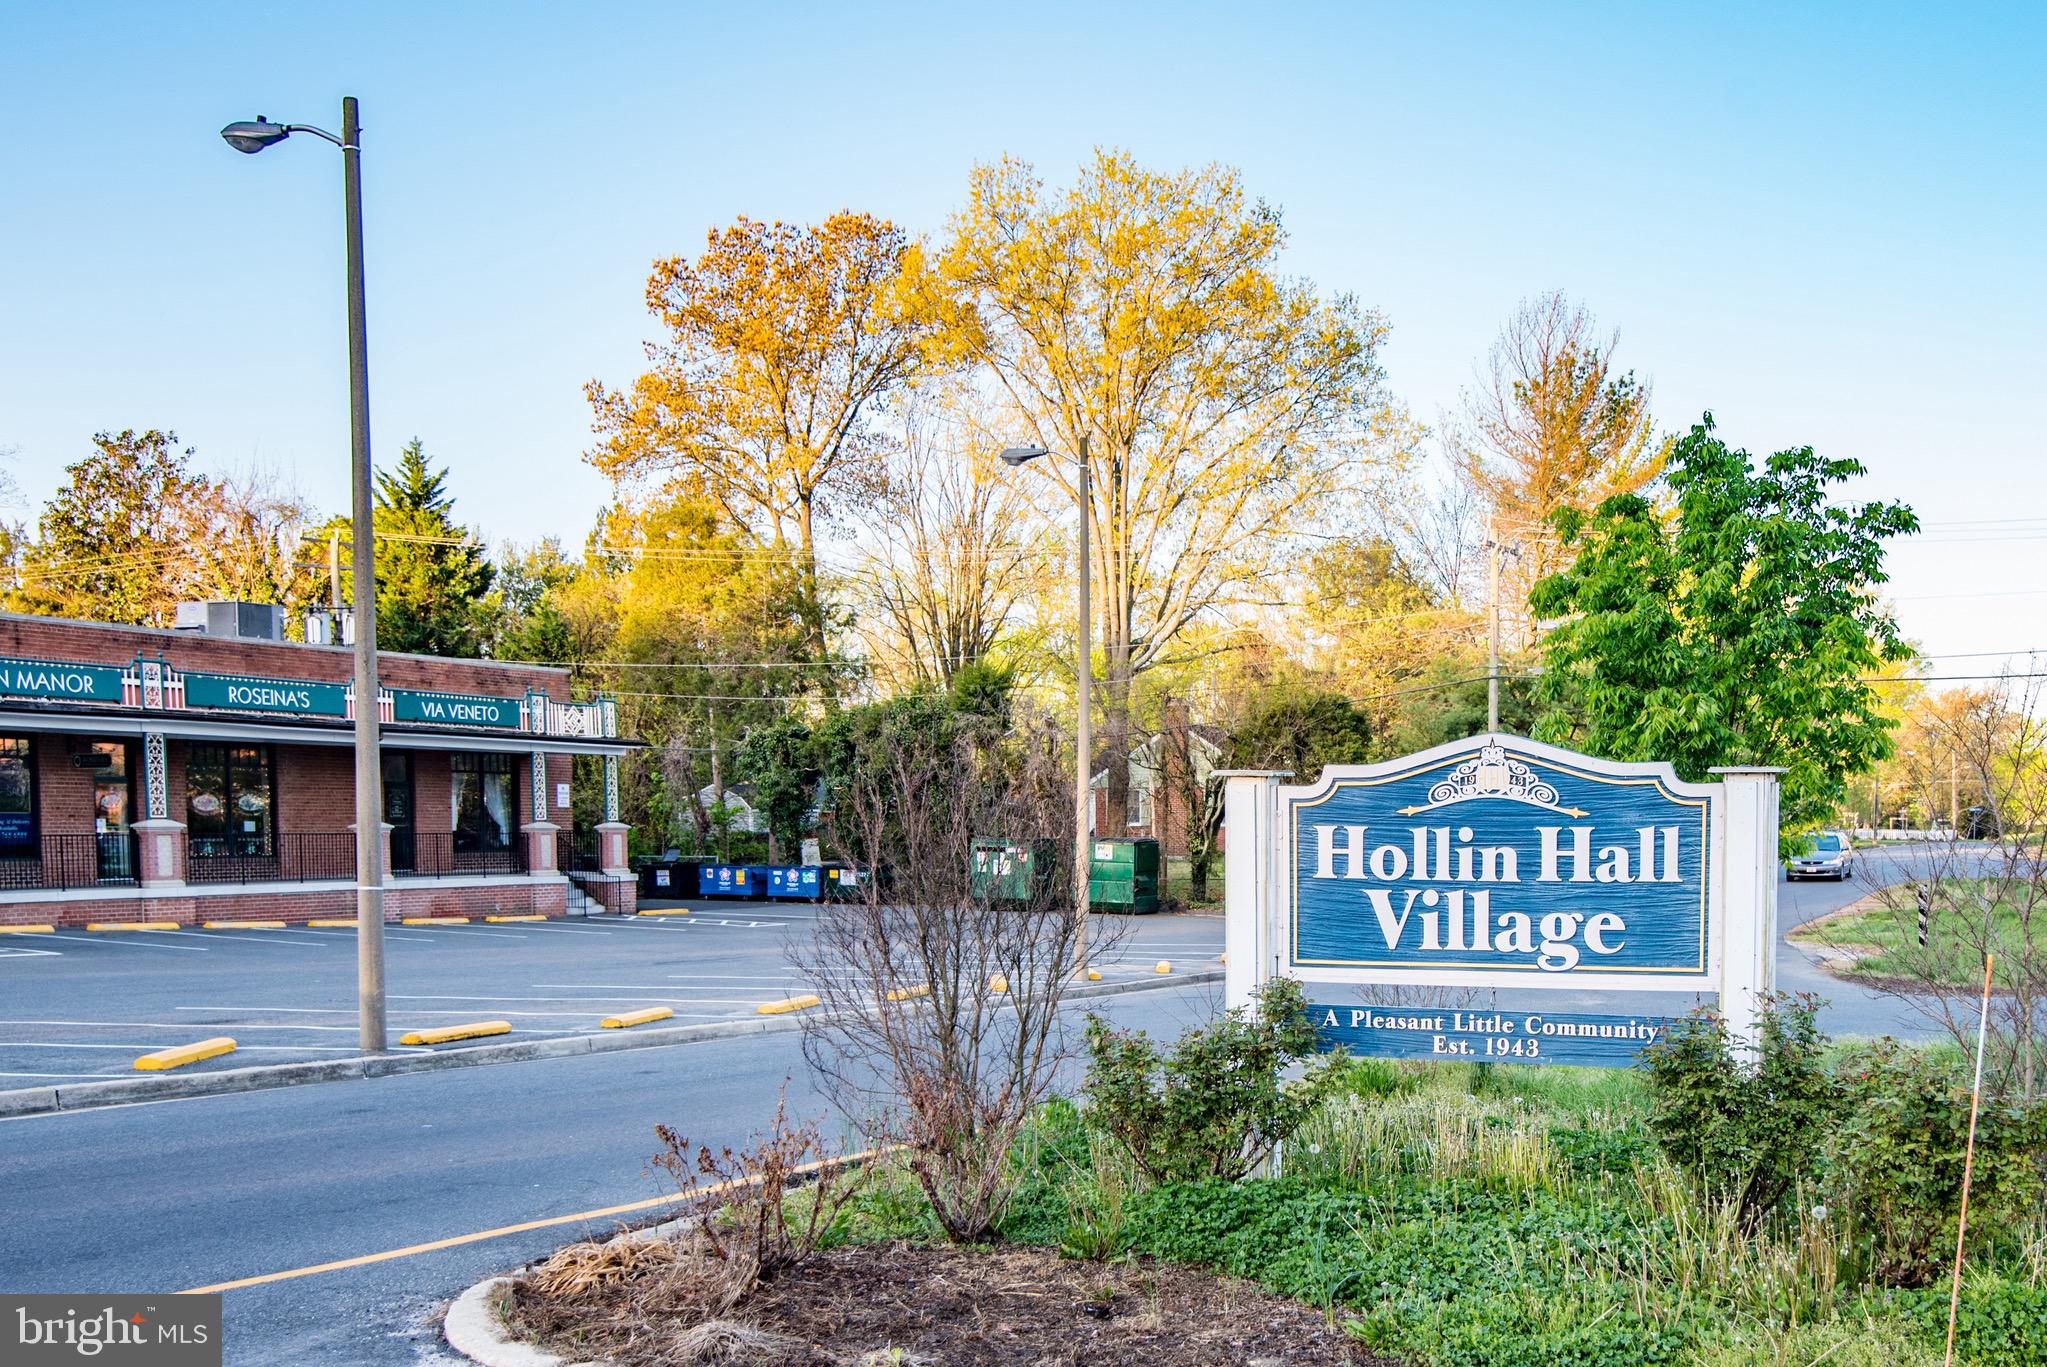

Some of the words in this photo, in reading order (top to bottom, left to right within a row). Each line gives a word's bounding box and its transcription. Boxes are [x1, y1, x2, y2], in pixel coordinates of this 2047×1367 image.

[16, 670, 94, 694] MANOR
[228, 686, 311, 708] ROSEINA'S
[421, 701, 446, 718] VIA
[448, 703, 500, 722] VENETO
[1464, 776, 1475, 785] 19
[1511, 776, 1524, 786] 43
[1312, 825, 1521, 882] Hollin
[1535, 825, 1684, 883] Hall
[1362, 888, 1627, 972] Village
[1322, 1008, 1340, 1027] A
[1350, 1010, 1446, 1031] Pleasant
[1453, 1013, 1515, 1034] Little
[1524, 1016, 1659, 1044] Community
[1432, 1035, 1475, 1055] Est.
[1485, 1037, 1539, 1058] 1943
